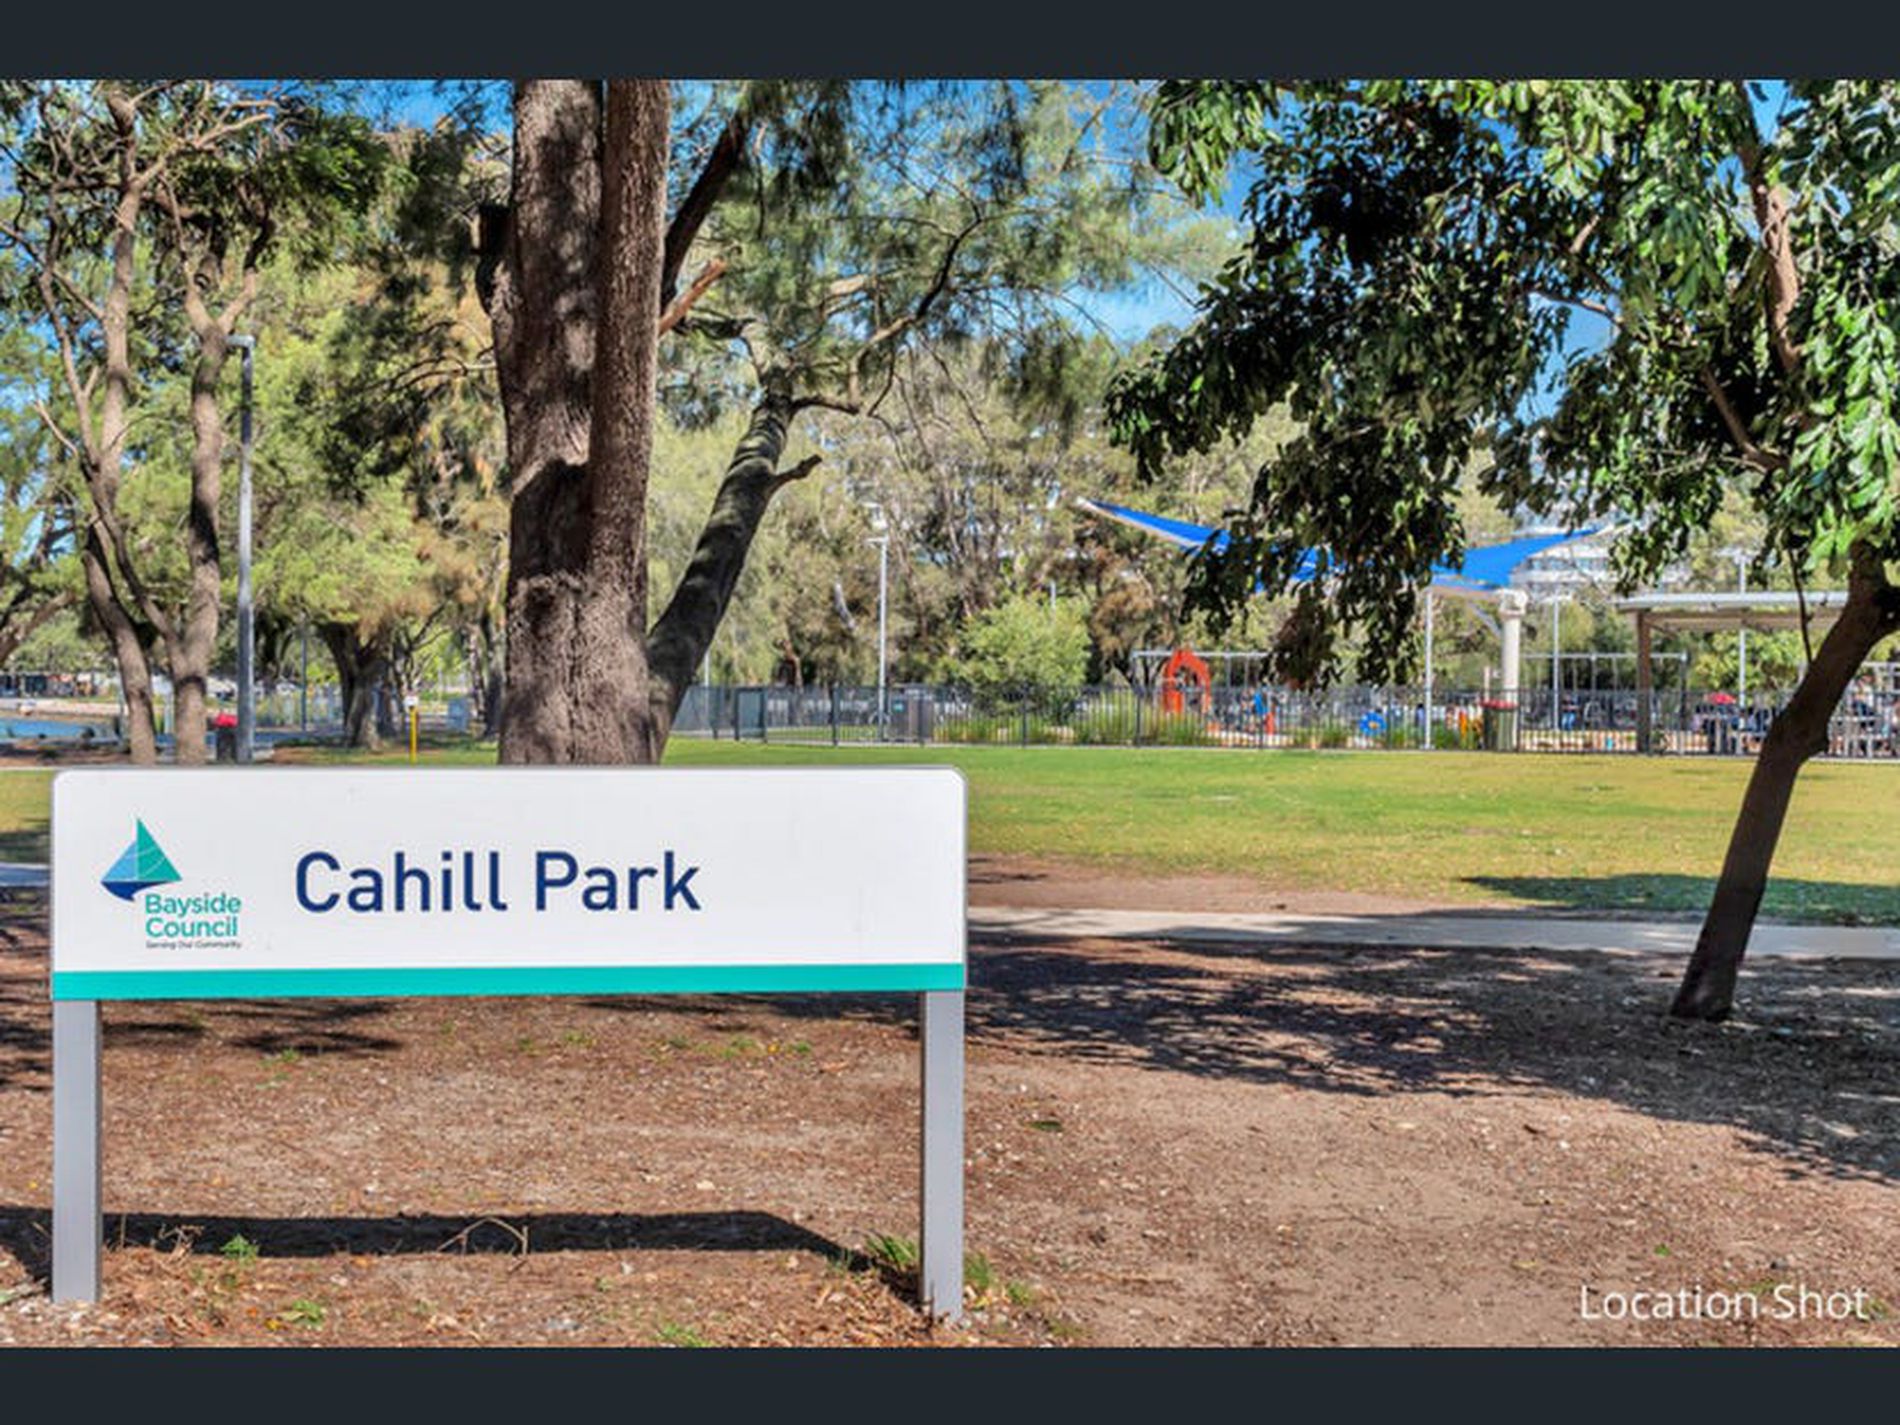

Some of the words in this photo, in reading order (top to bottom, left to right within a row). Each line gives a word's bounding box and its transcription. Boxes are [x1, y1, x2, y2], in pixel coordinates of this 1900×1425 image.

[295, 850, 508, 914] Cahill
[535, 849, 702, 912] Park
[144, 893, 242, 918] Bayside
[144, 918, 239, 938] Council
